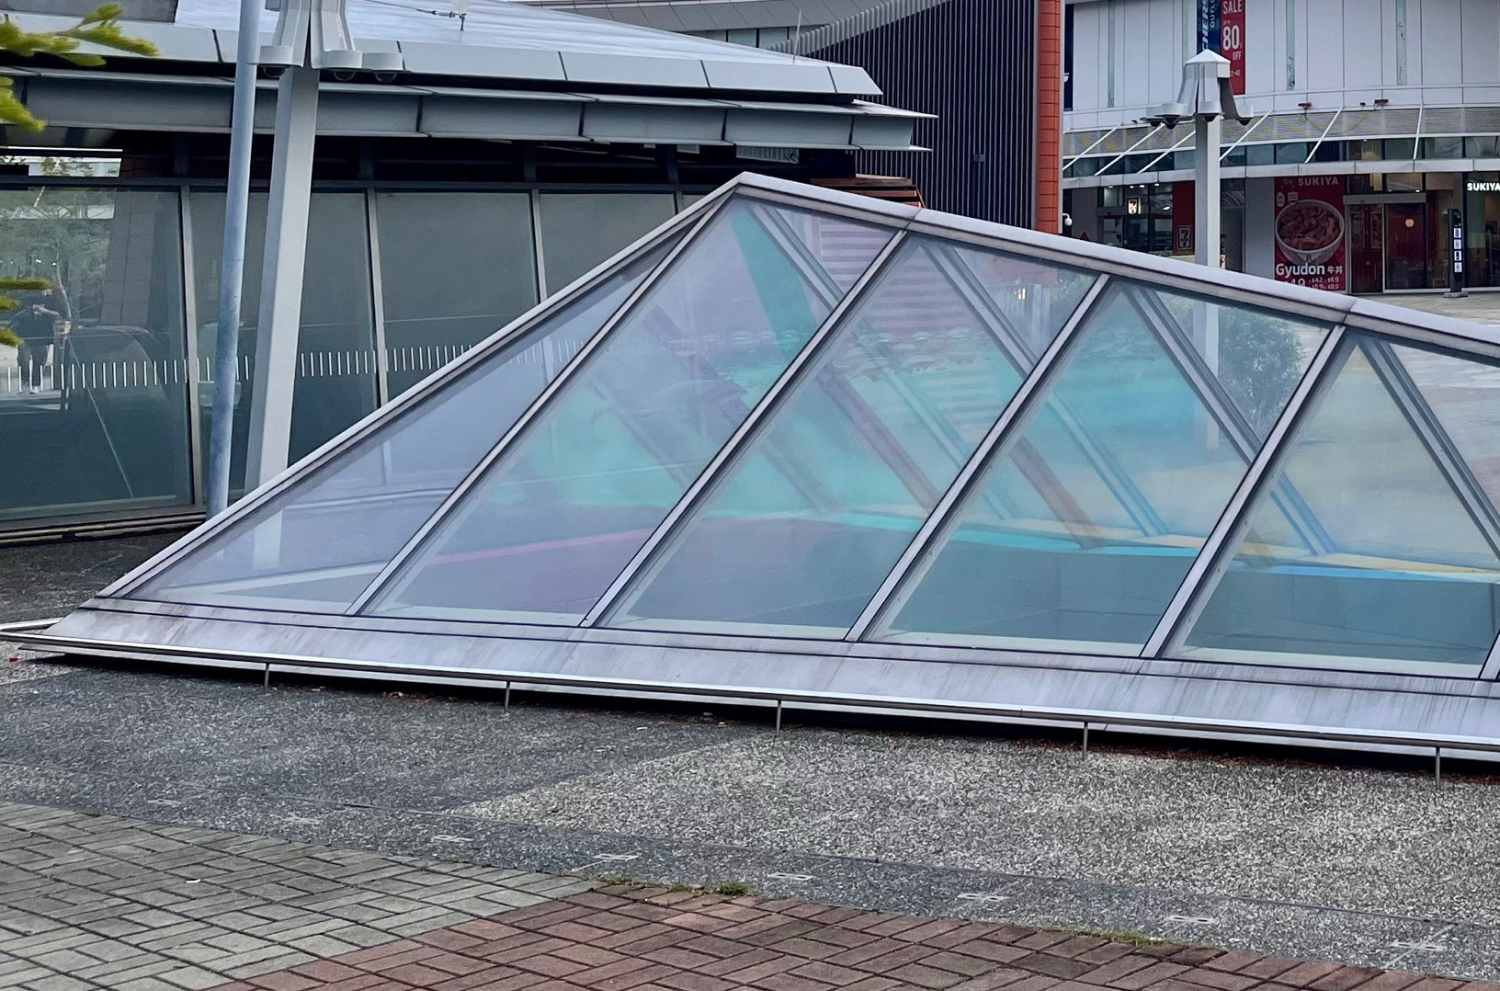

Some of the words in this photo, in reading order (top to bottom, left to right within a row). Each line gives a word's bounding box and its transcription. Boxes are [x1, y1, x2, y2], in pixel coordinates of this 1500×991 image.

[1223, 0, 1243, 14] SALE
[1298, 177, 1339, 186] SUKIYA
[1276, 262, 1325, 278] Gyudon
